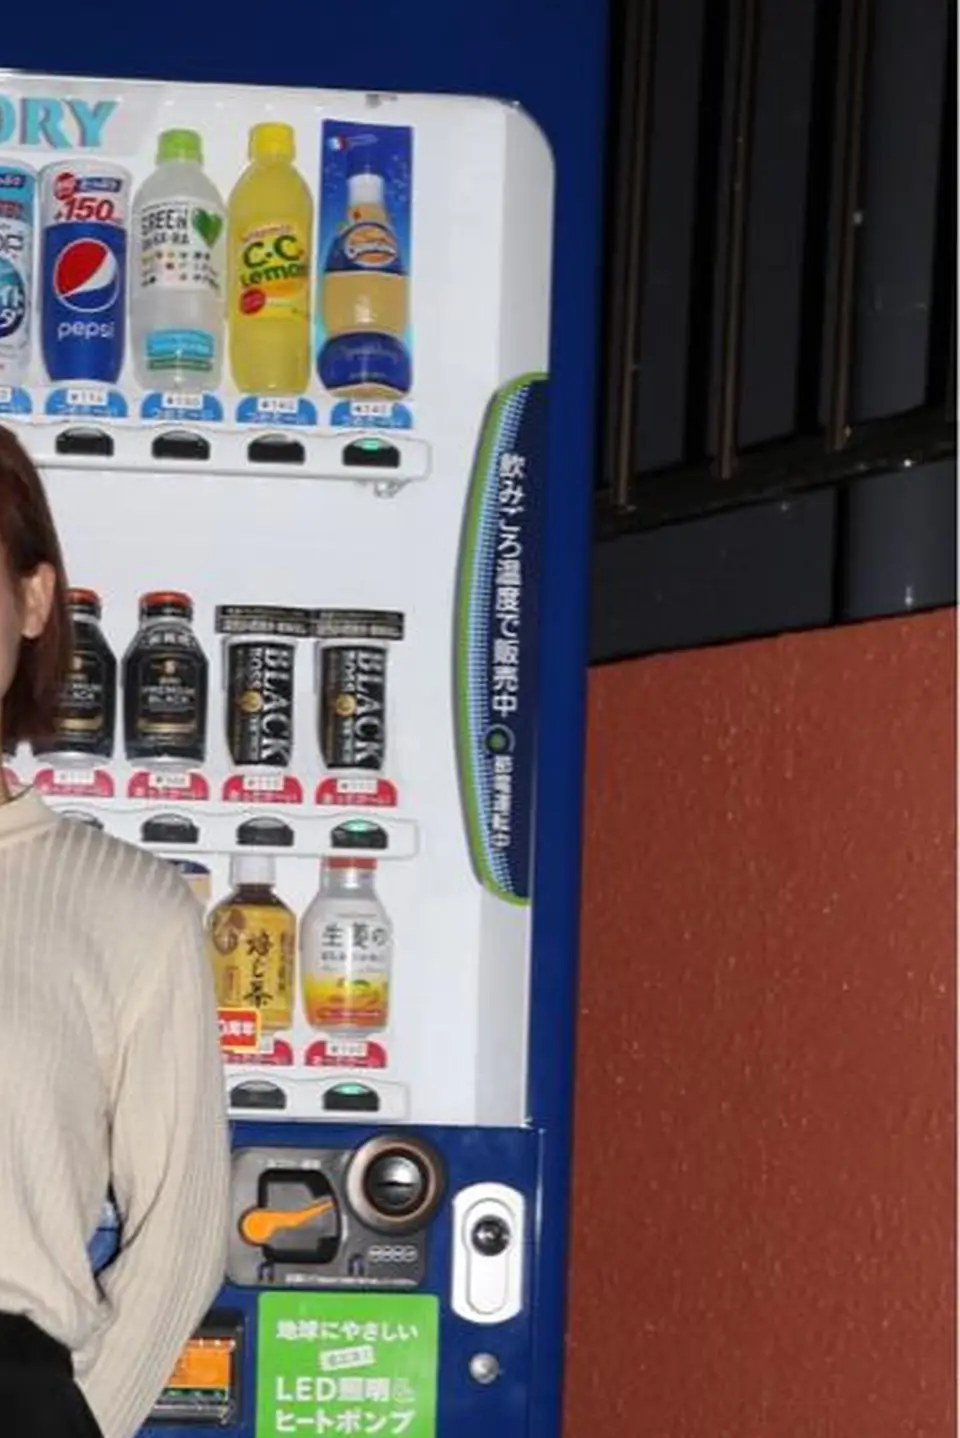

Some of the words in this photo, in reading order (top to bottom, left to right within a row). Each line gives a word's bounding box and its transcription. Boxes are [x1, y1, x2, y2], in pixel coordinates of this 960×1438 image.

[57, 321, 115, 341] pepsi
[259, 648, 291, 762] BLACK
[353, 651, 385, 765] BLACK
[276, 1319, 419, 1341] 地球にやさしい
[275, 1406, 416, 1434] ヒートポンプ
